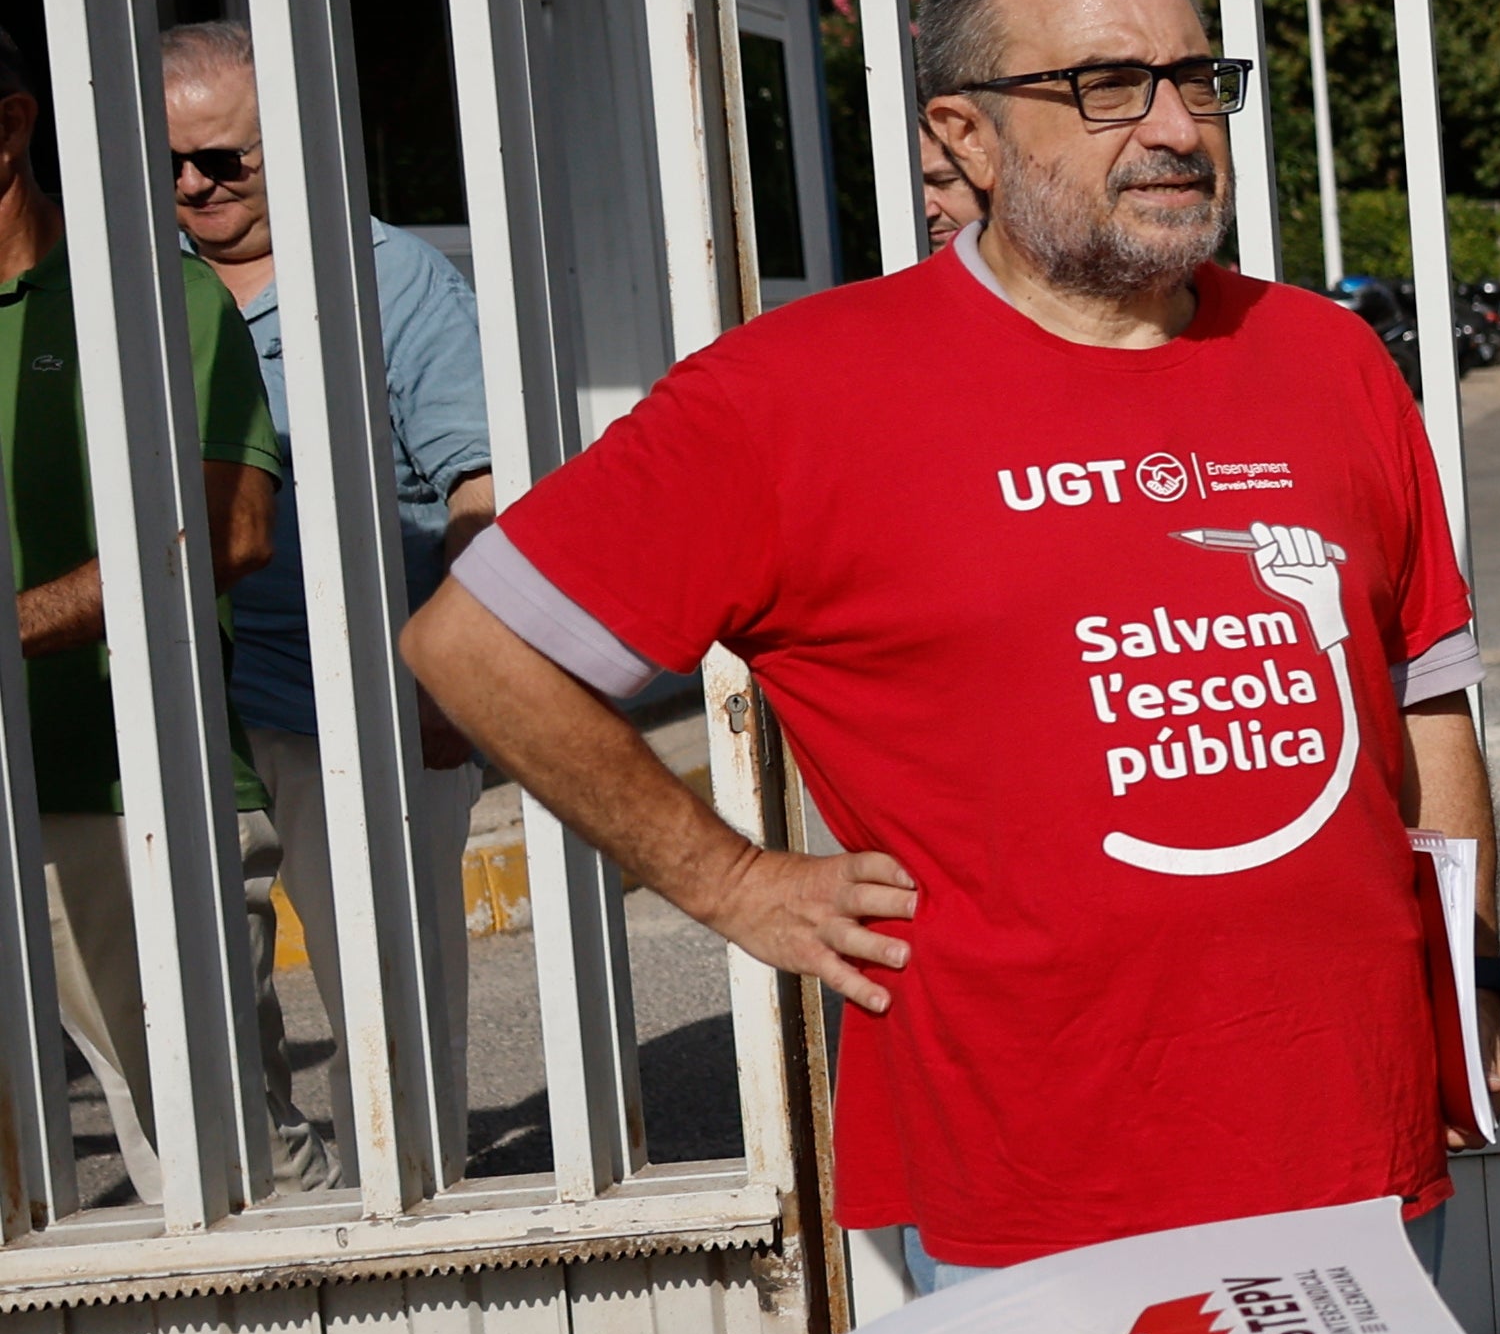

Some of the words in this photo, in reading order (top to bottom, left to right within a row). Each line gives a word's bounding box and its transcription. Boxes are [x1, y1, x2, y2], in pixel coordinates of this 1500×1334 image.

[998, 459, 1127, 511] UGT
[1205, 461, 1291, 478] Ensenyament
[1210, 480, 1247, 493] Serveis
[1075, 605, 1298, 663] Salvem
[1090, 659, 1318, 724] l'escola
[1106, 720, 1326, 797] pública
